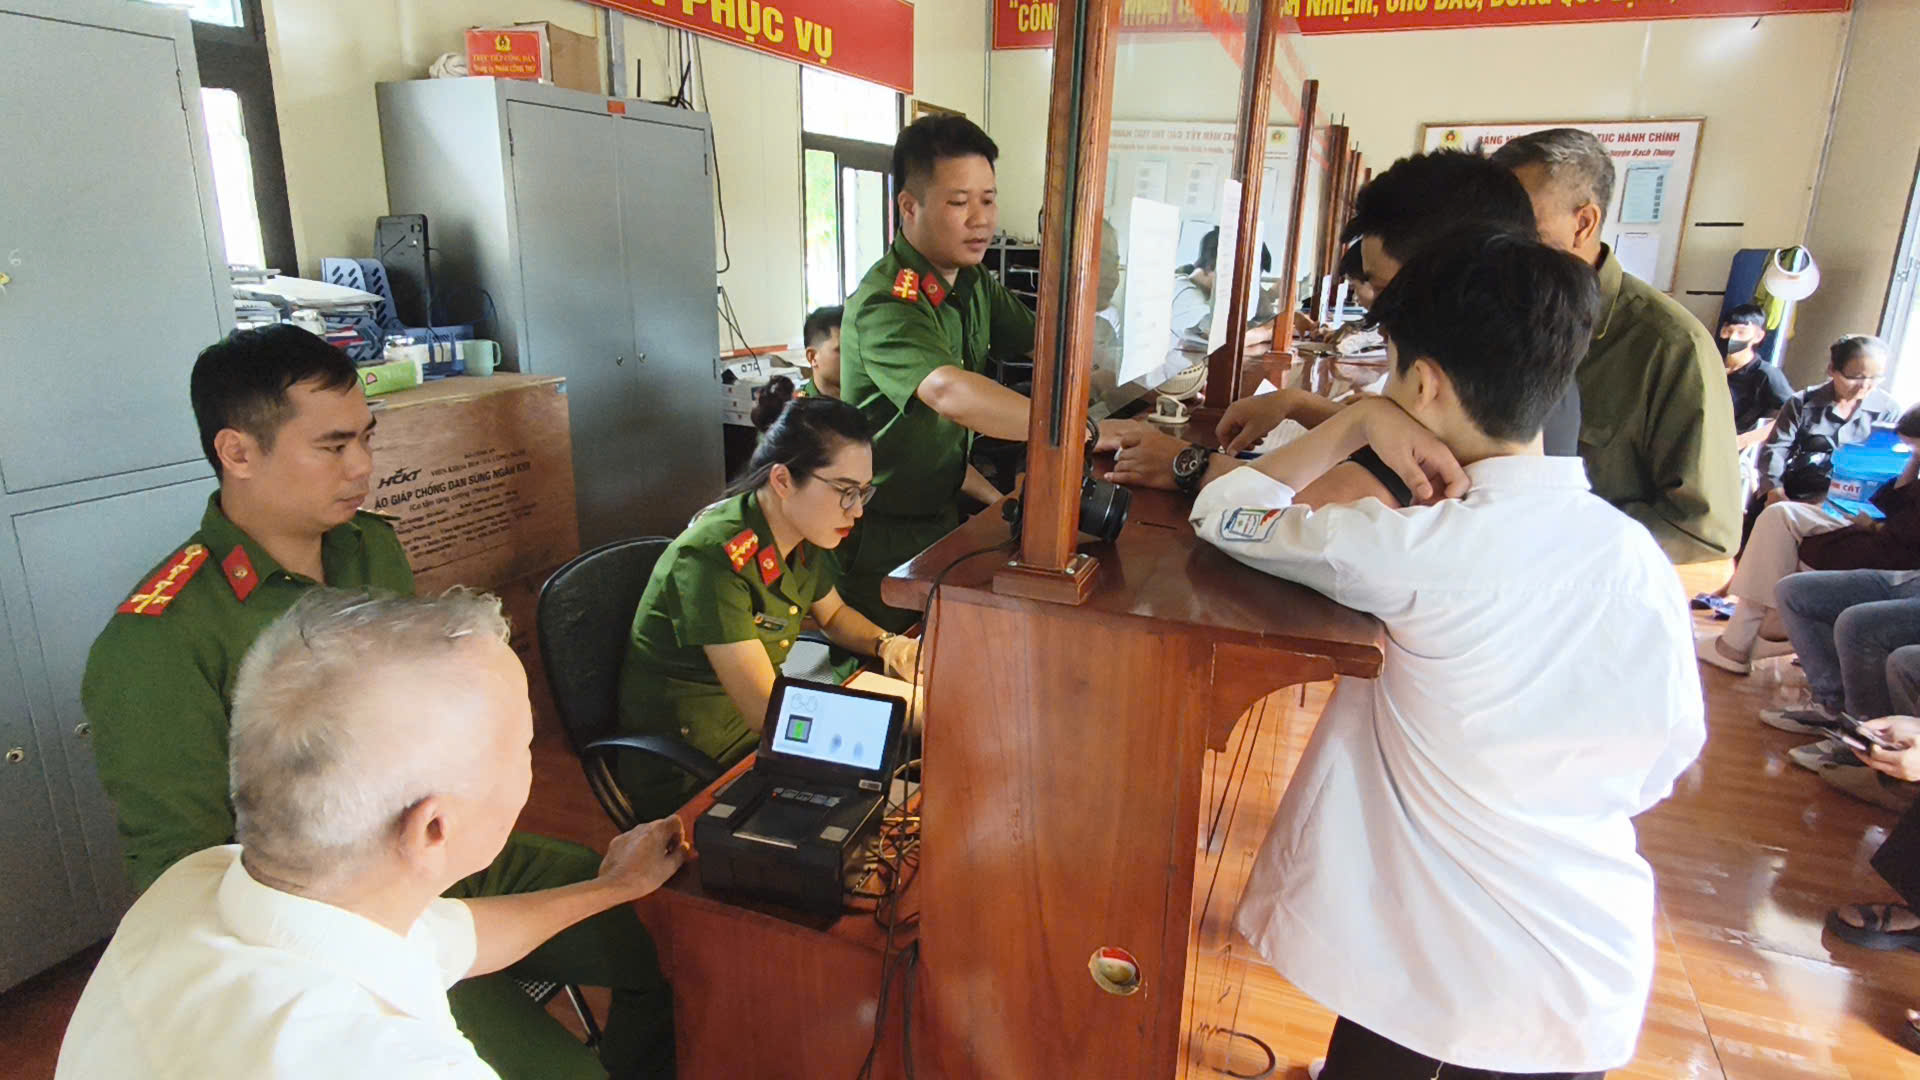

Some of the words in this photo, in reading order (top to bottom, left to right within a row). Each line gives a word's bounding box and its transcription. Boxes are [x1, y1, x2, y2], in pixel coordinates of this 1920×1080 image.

[1009, 0, 1056, 32] “CÔN
[794, 16, 832, 64] VỤ
[391, 490, 413, 506] GIÁP
[415, 480, 447, 499] CHỐNG
